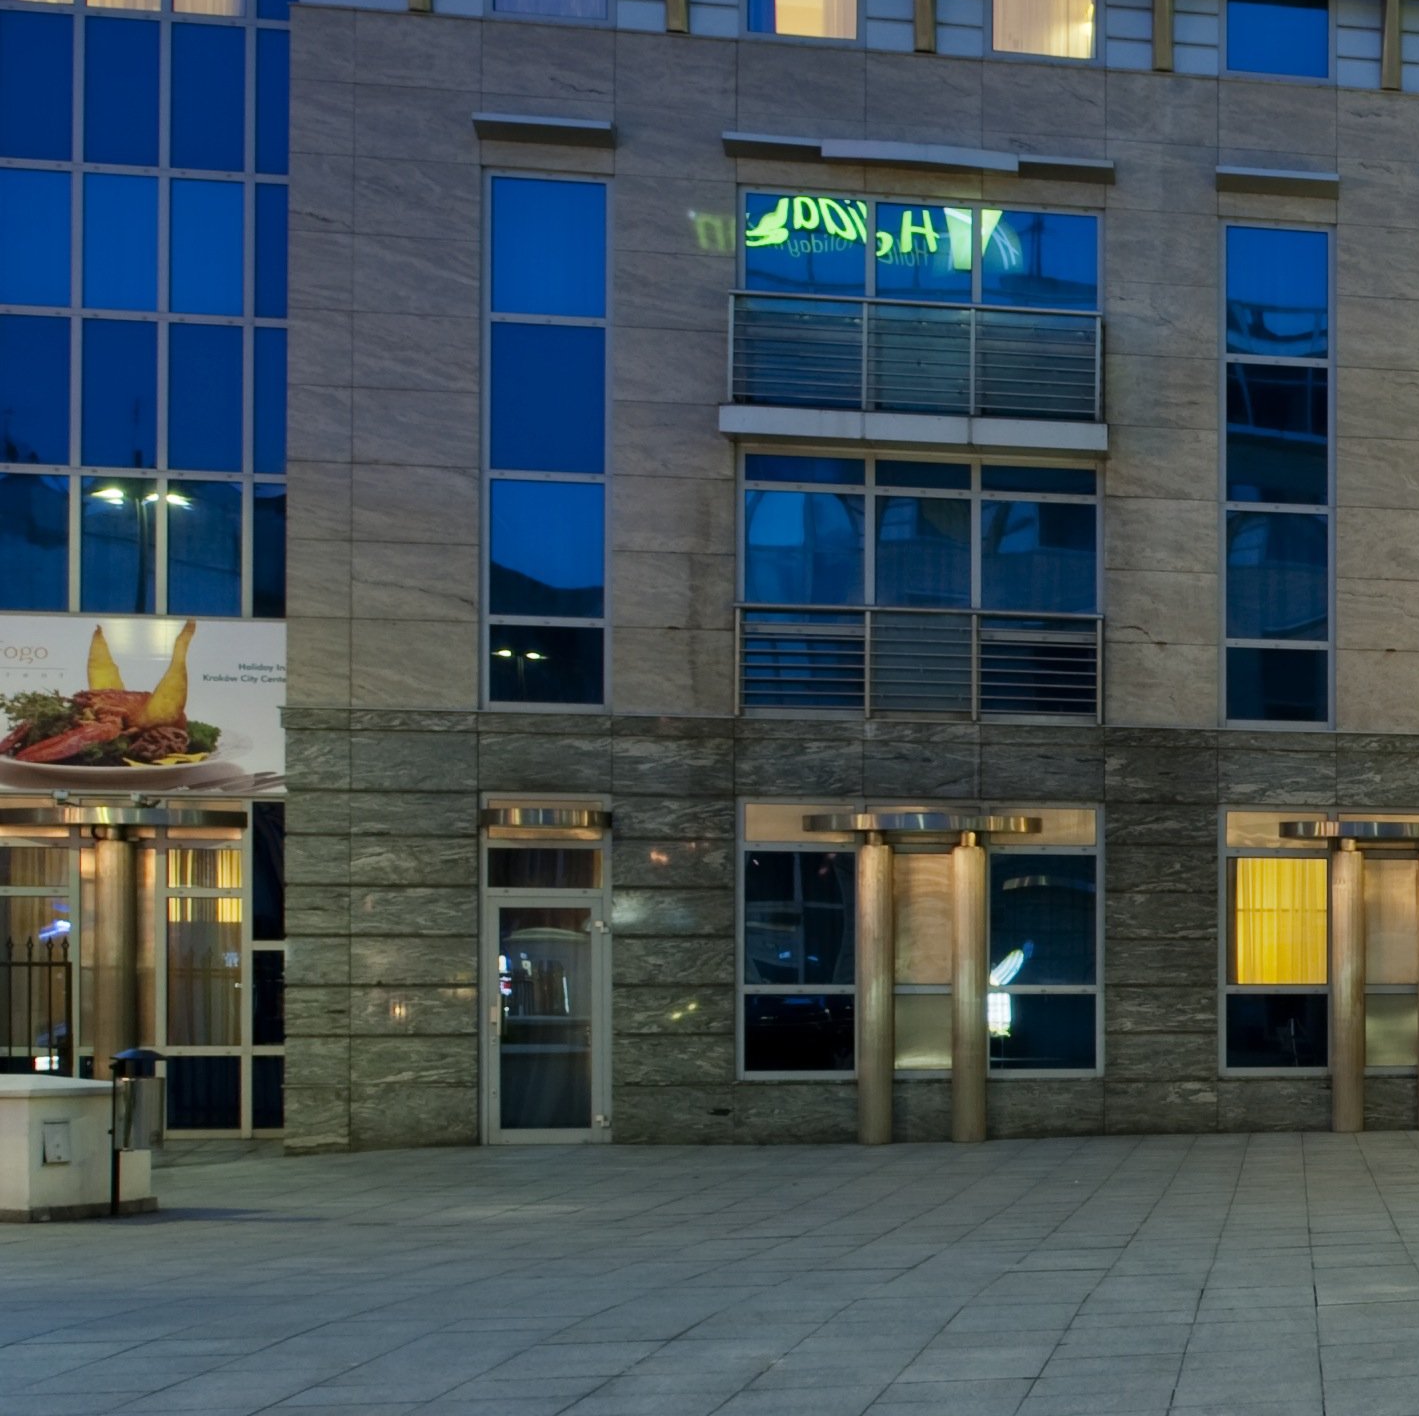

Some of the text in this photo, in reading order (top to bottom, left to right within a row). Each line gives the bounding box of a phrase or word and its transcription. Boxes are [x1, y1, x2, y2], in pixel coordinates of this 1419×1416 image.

[0, 646, 49, 664] ogo
[238, 663, 274, 673] Holiday
[240, 674, 258, 684] City
